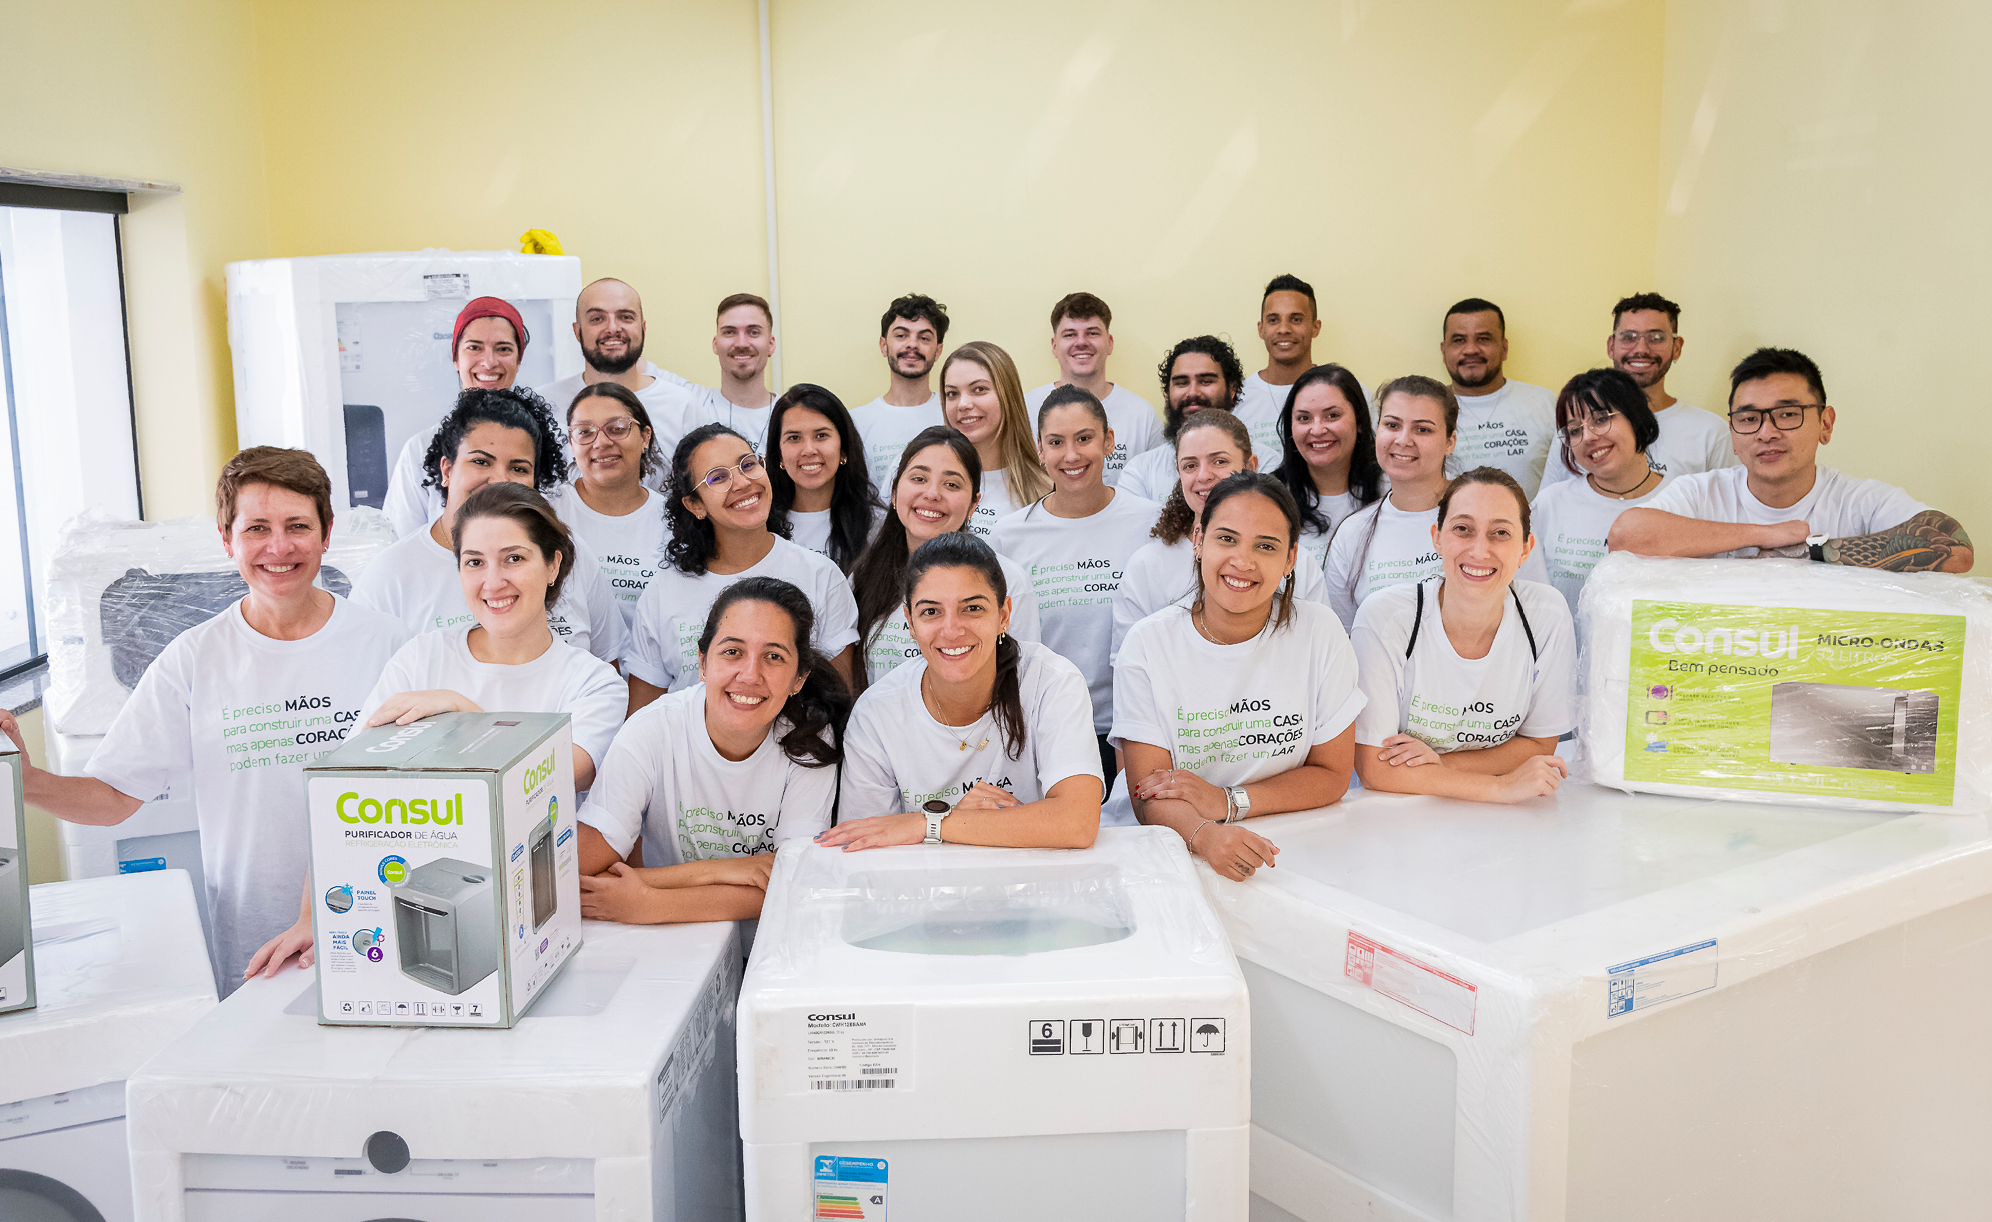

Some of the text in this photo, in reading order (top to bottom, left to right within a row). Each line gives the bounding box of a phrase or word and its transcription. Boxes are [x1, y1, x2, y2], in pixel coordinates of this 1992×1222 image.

[1505, 430, 1527, 438] CASA
[975, 504, 995, 516] ÃOS
[1558, 532, 1564, 542] É
[1566, 536, 1601, 546] preciso
[1555, 547, 1574, 555] para
[607, 554, 640, 566] MÃOS
[1032, 558, 1111, 575] É preciso MÃOS
[1369, 552, 1442, 570] É preciso MÃO
[1572, 561, 1595, 569] apen
[1052, 574, 1089, 583] construir
[1091, 572, 1111, 580] uma
[1369, 573, 1386, 584] para
[1388, 569, 1426, 579] construir
[1051, 586, 1083, 596] apenas
[1038, 595, 1113, 610] odem fazer um
[436, 616, 444, 627] É
[1650, 618, 1800, 660] Consul
[1817, 634, 1945, 653] MICRO-ONDAS
[1838, 648, 1900, 665] LITROS
[1668, 659, 1780, 678] Bem pensado
[222, 696, 331, 720] É preciso MÃOS
[1178, 698, 1271, 723] É preciso MÃOS
[1412, 694, 1421, 707] É
[1421, 701, 1459, 716] preciso
[224, 726, 246, 739] para
[250, 716, 302, 733] construir
[305, 716, 332, 727] uma
[1178, 727, 1200, 738] para
[1202, 720, 1244, 737] construir
[1246, 719, 1272, 729] uma
[1467, 719, 1492, 730] uma
[1494, 714, 1521, 730] CASA
[226, 742, 248, 754] mas
[250, 736, 294, 752] apenas
[366, 722, 438, 753] Consul
[1178, 728, 1303, 754] mas apenas CORAÇÕES
[230, 756, 271, 772] podem
[275, 752, 308, 765] fazer
[1180, 754, 1216, 770] podem
[1220, 751, 1248, 764] fazer
[1271, 745, 1295, 758] LAR
[524, 748, 556, 795] Consul
[902, 786, 959, 805] É preciso
[336, 792, 463, 825] Consul
[686, 807, 724, 821] preciso
[344, 830, 458, 840] PURIFICADOR DE ÁGUA
[345, 839, 458, 849] REFRIGERAÇÃO ELETRÔNICA
[371, 949, 379, 958] 6
[1041, 1022, 1052, 1038] 6
